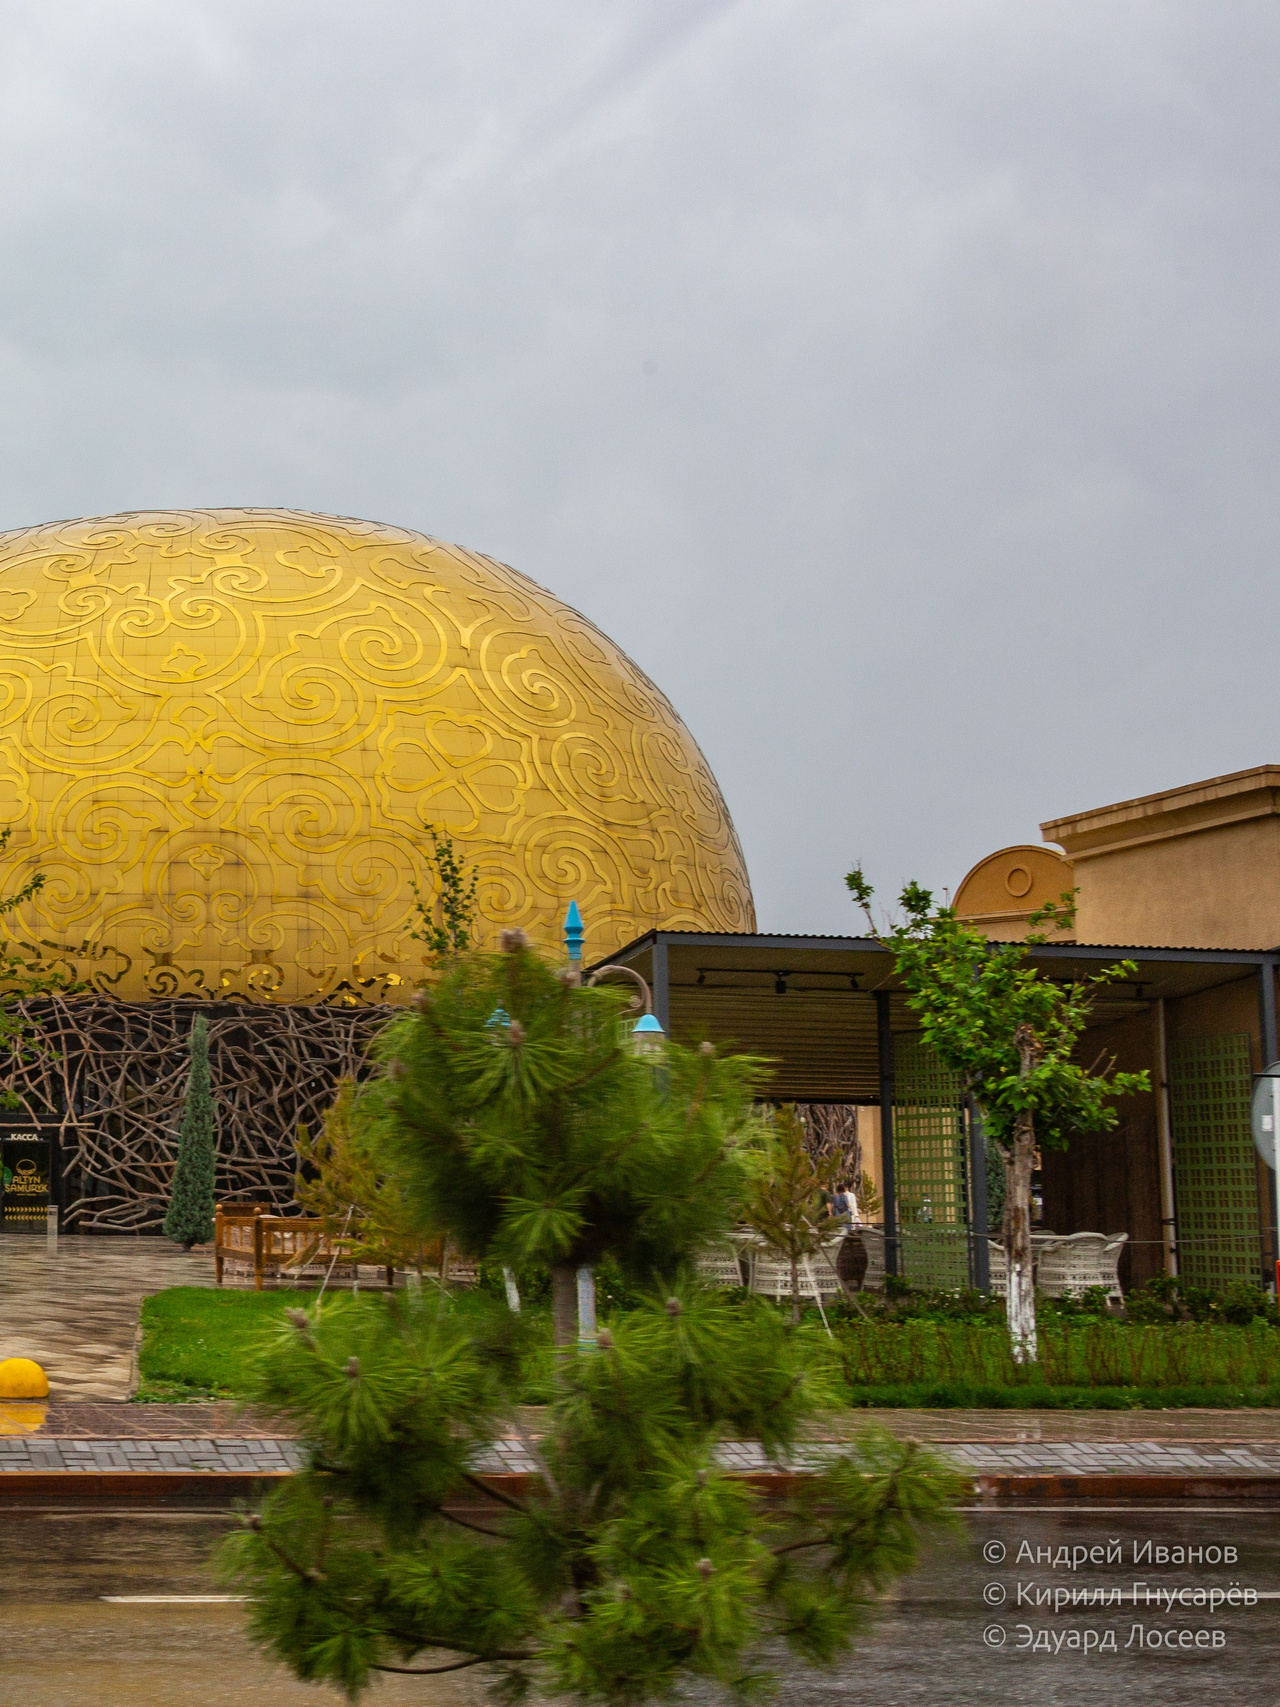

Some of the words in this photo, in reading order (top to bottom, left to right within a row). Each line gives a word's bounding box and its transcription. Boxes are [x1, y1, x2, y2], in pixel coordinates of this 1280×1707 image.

[10, 1133, 38, 1141] КАССА
[12, 1176, 40, 1185] ALTYN
[4, 1184, 48, 1193] SAMURYK
